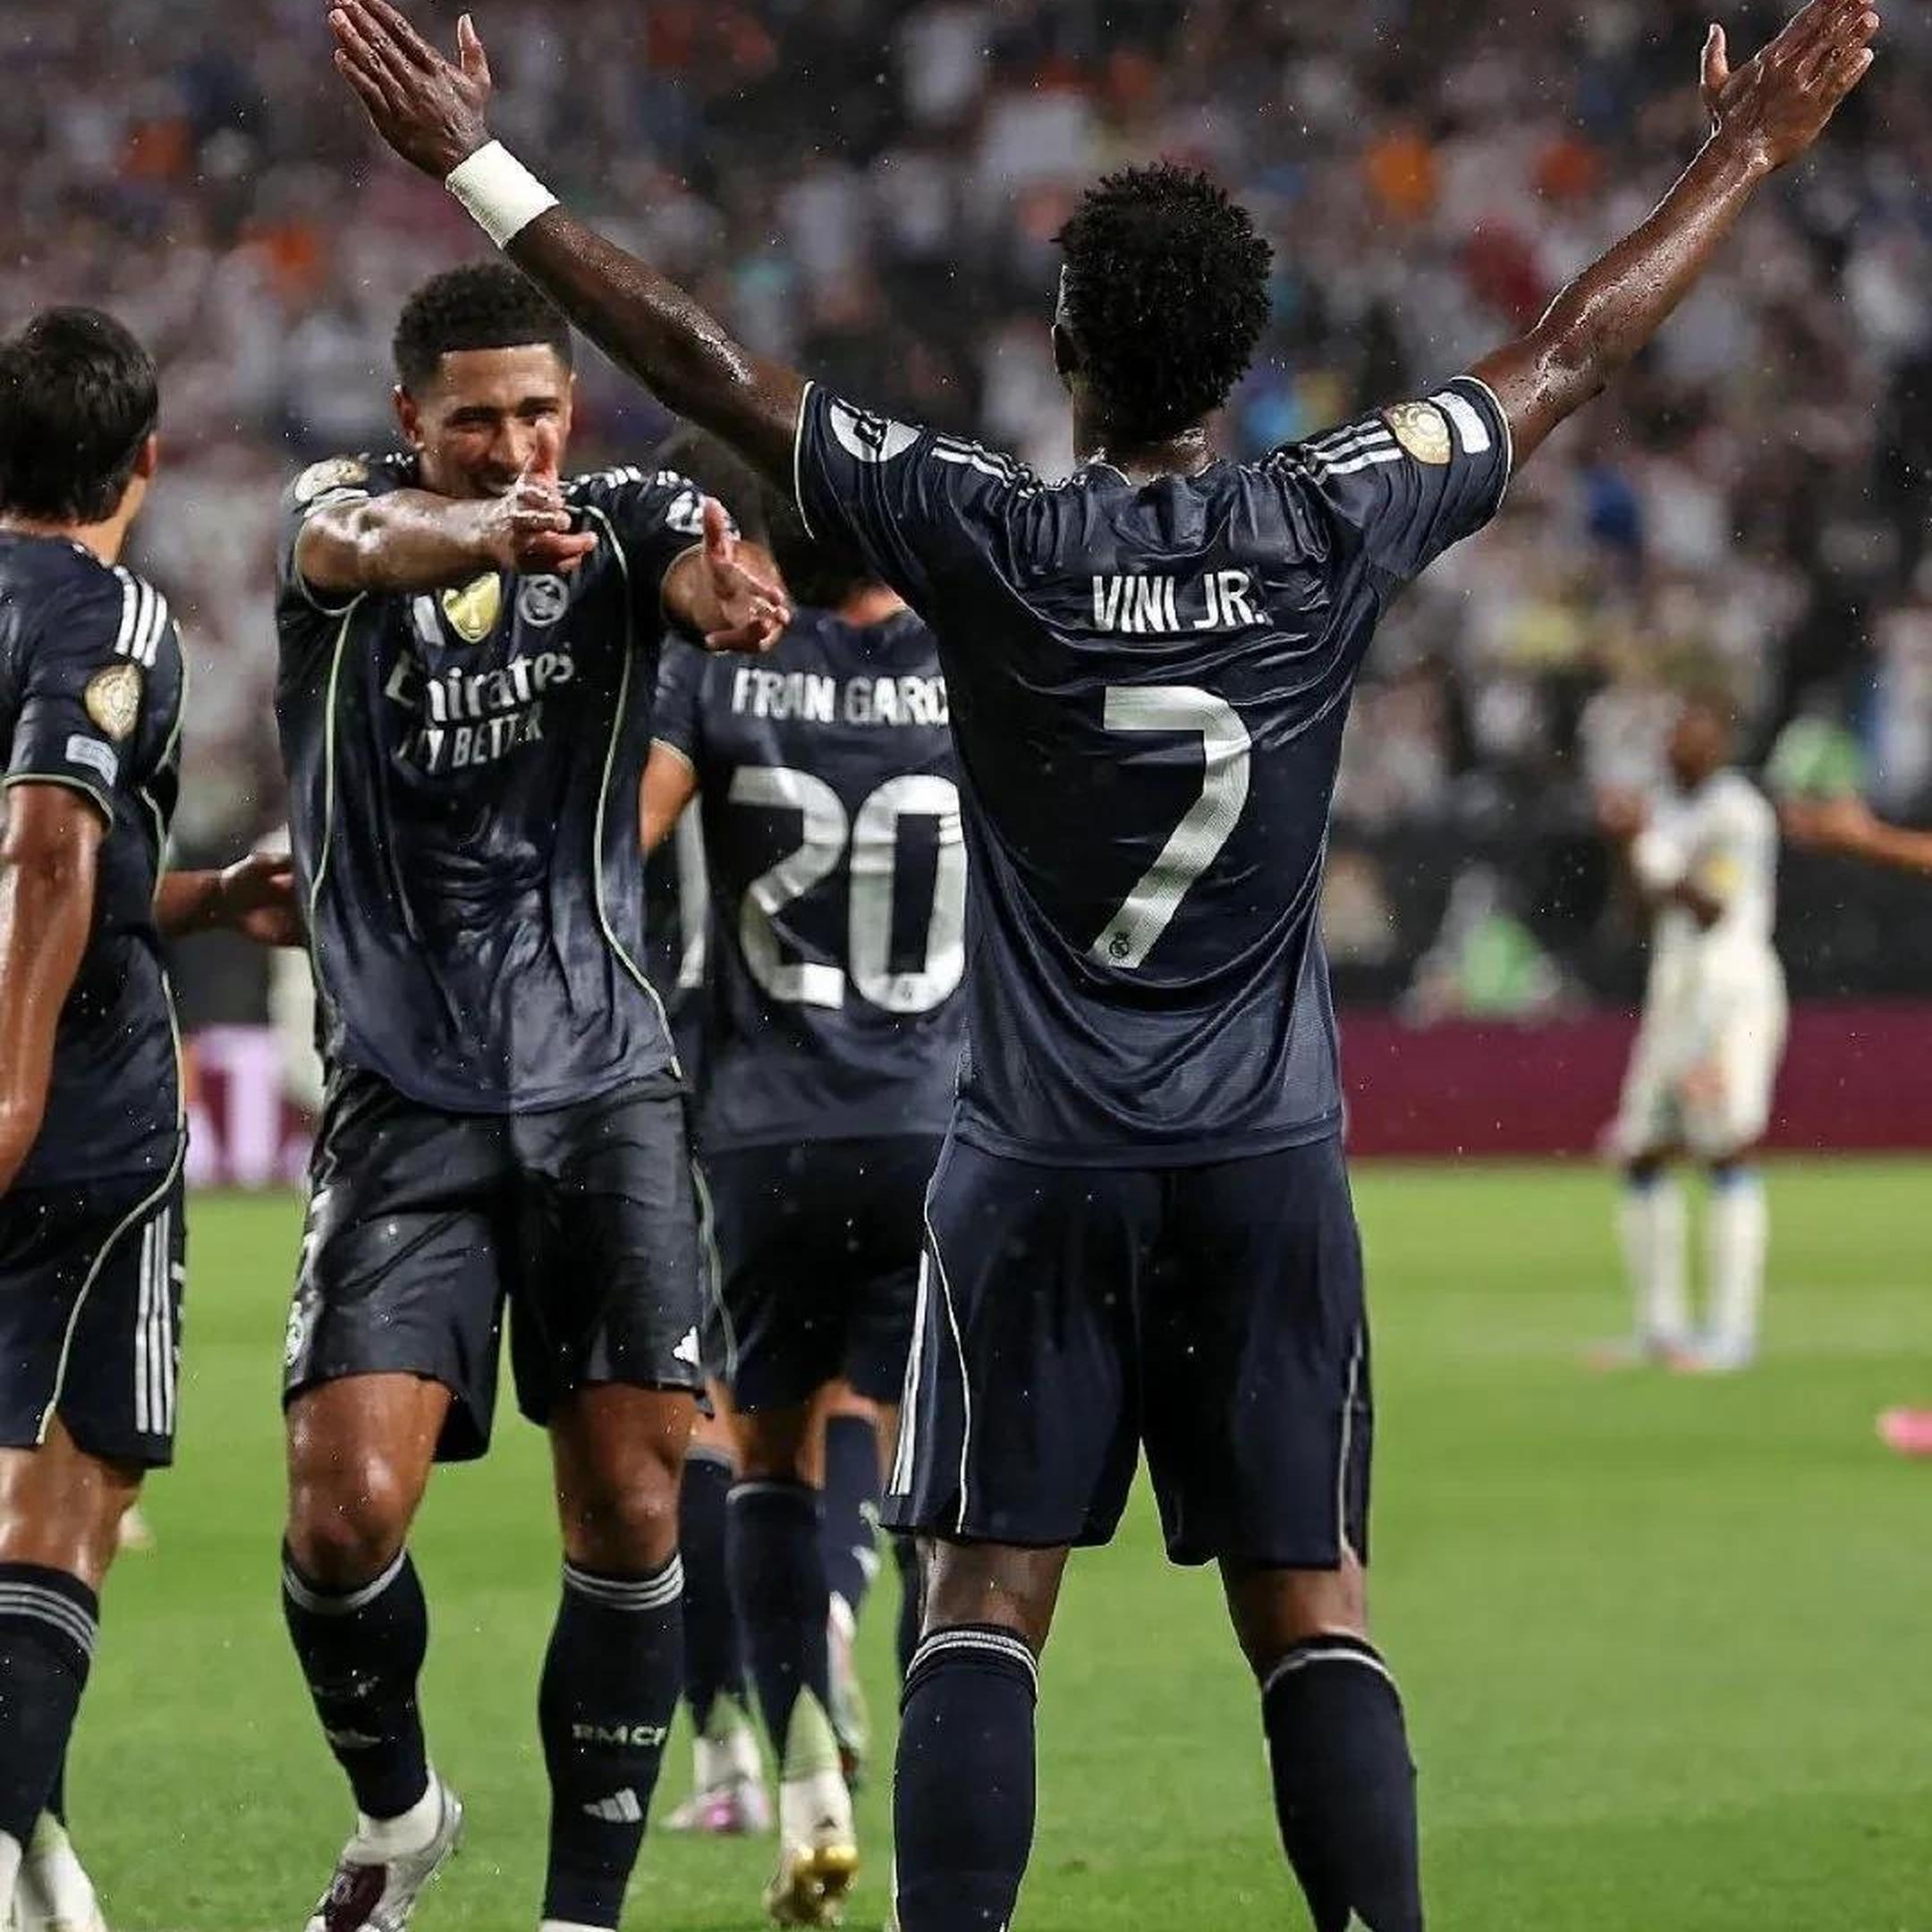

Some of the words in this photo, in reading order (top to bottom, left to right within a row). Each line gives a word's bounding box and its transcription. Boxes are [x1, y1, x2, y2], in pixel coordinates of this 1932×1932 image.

[1093, 575, 1180, 632] VINI
[1193, 571, 1265, 629] JR.
[732, 668, 836, 724] FRAN
[452, 703, 543, 768] BETTR
[1090, 685, 1250, 969] 7
[728, 766, 969, 1013] 20
